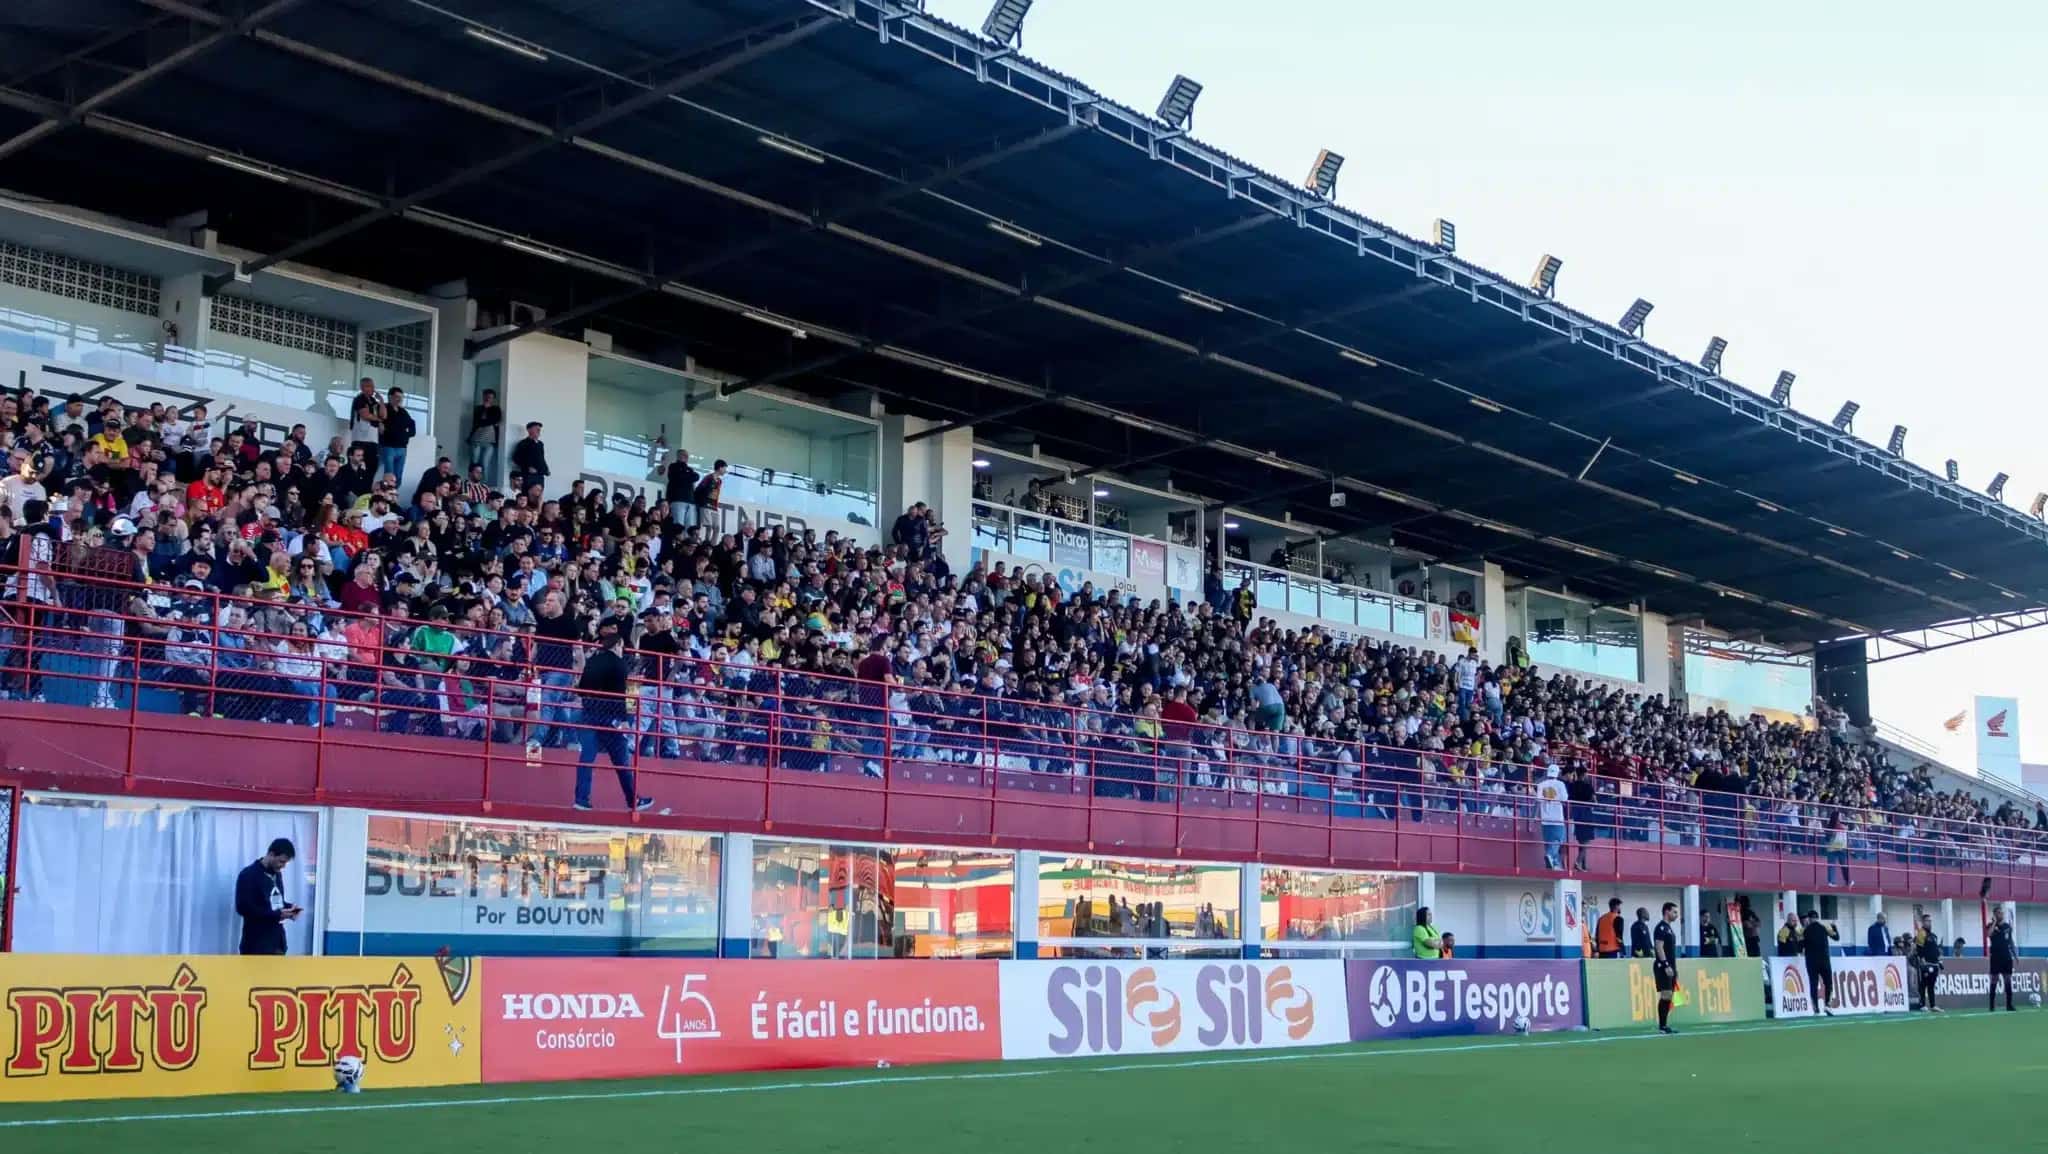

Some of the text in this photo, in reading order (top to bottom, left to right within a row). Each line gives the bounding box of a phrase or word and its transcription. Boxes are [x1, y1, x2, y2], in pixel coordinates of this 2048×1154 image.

[476, 905, 605, 925] Por BOUTON
[2009, 967, 2032, 993] ÉRIE
[502, 993, 645, 1020] HONDA
[1782, 995, 1808, 1013] Aurora
[1883, 991, 1905, 1007] Aurora
[6, 962, 207, 1077] PITÚ
[248, 962, 422, 1070] PITÚ
[683, 1020, 707, 1031] ANOS
[751, 991, 985, 1040] É fácil e funciona.
[536, 1028, 616, 1049] Consórcio
